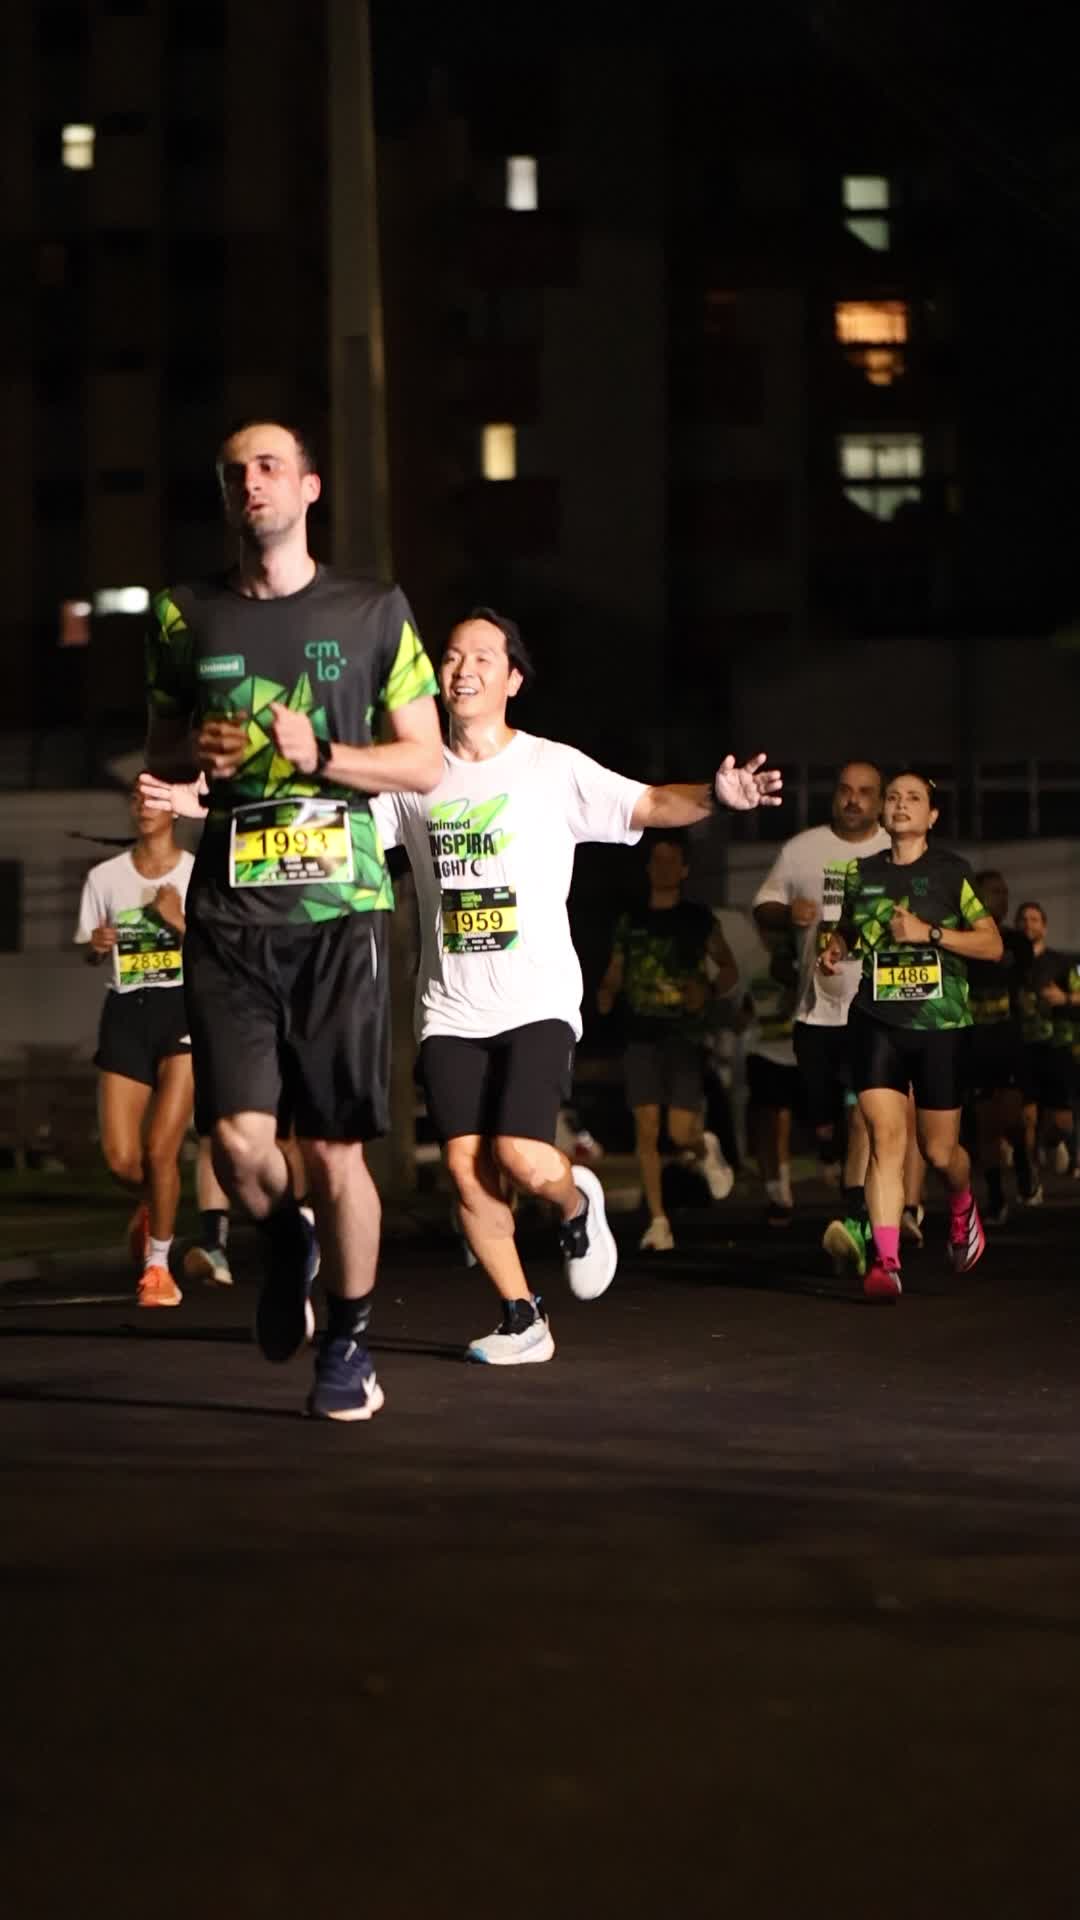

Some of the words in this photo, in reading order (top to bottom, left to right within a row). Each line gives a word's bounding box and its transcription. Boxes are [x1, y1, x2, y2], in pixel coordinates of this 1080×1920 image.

[304, 640, 340, 658] cm
[426, 818, 470, 832] Unimed
[255, 830, 328, 857] 1993
[452, 910, 503, 933] 1959
[130, 952, 173, 971] 2836
[888, 967, 929, 985] 1486
